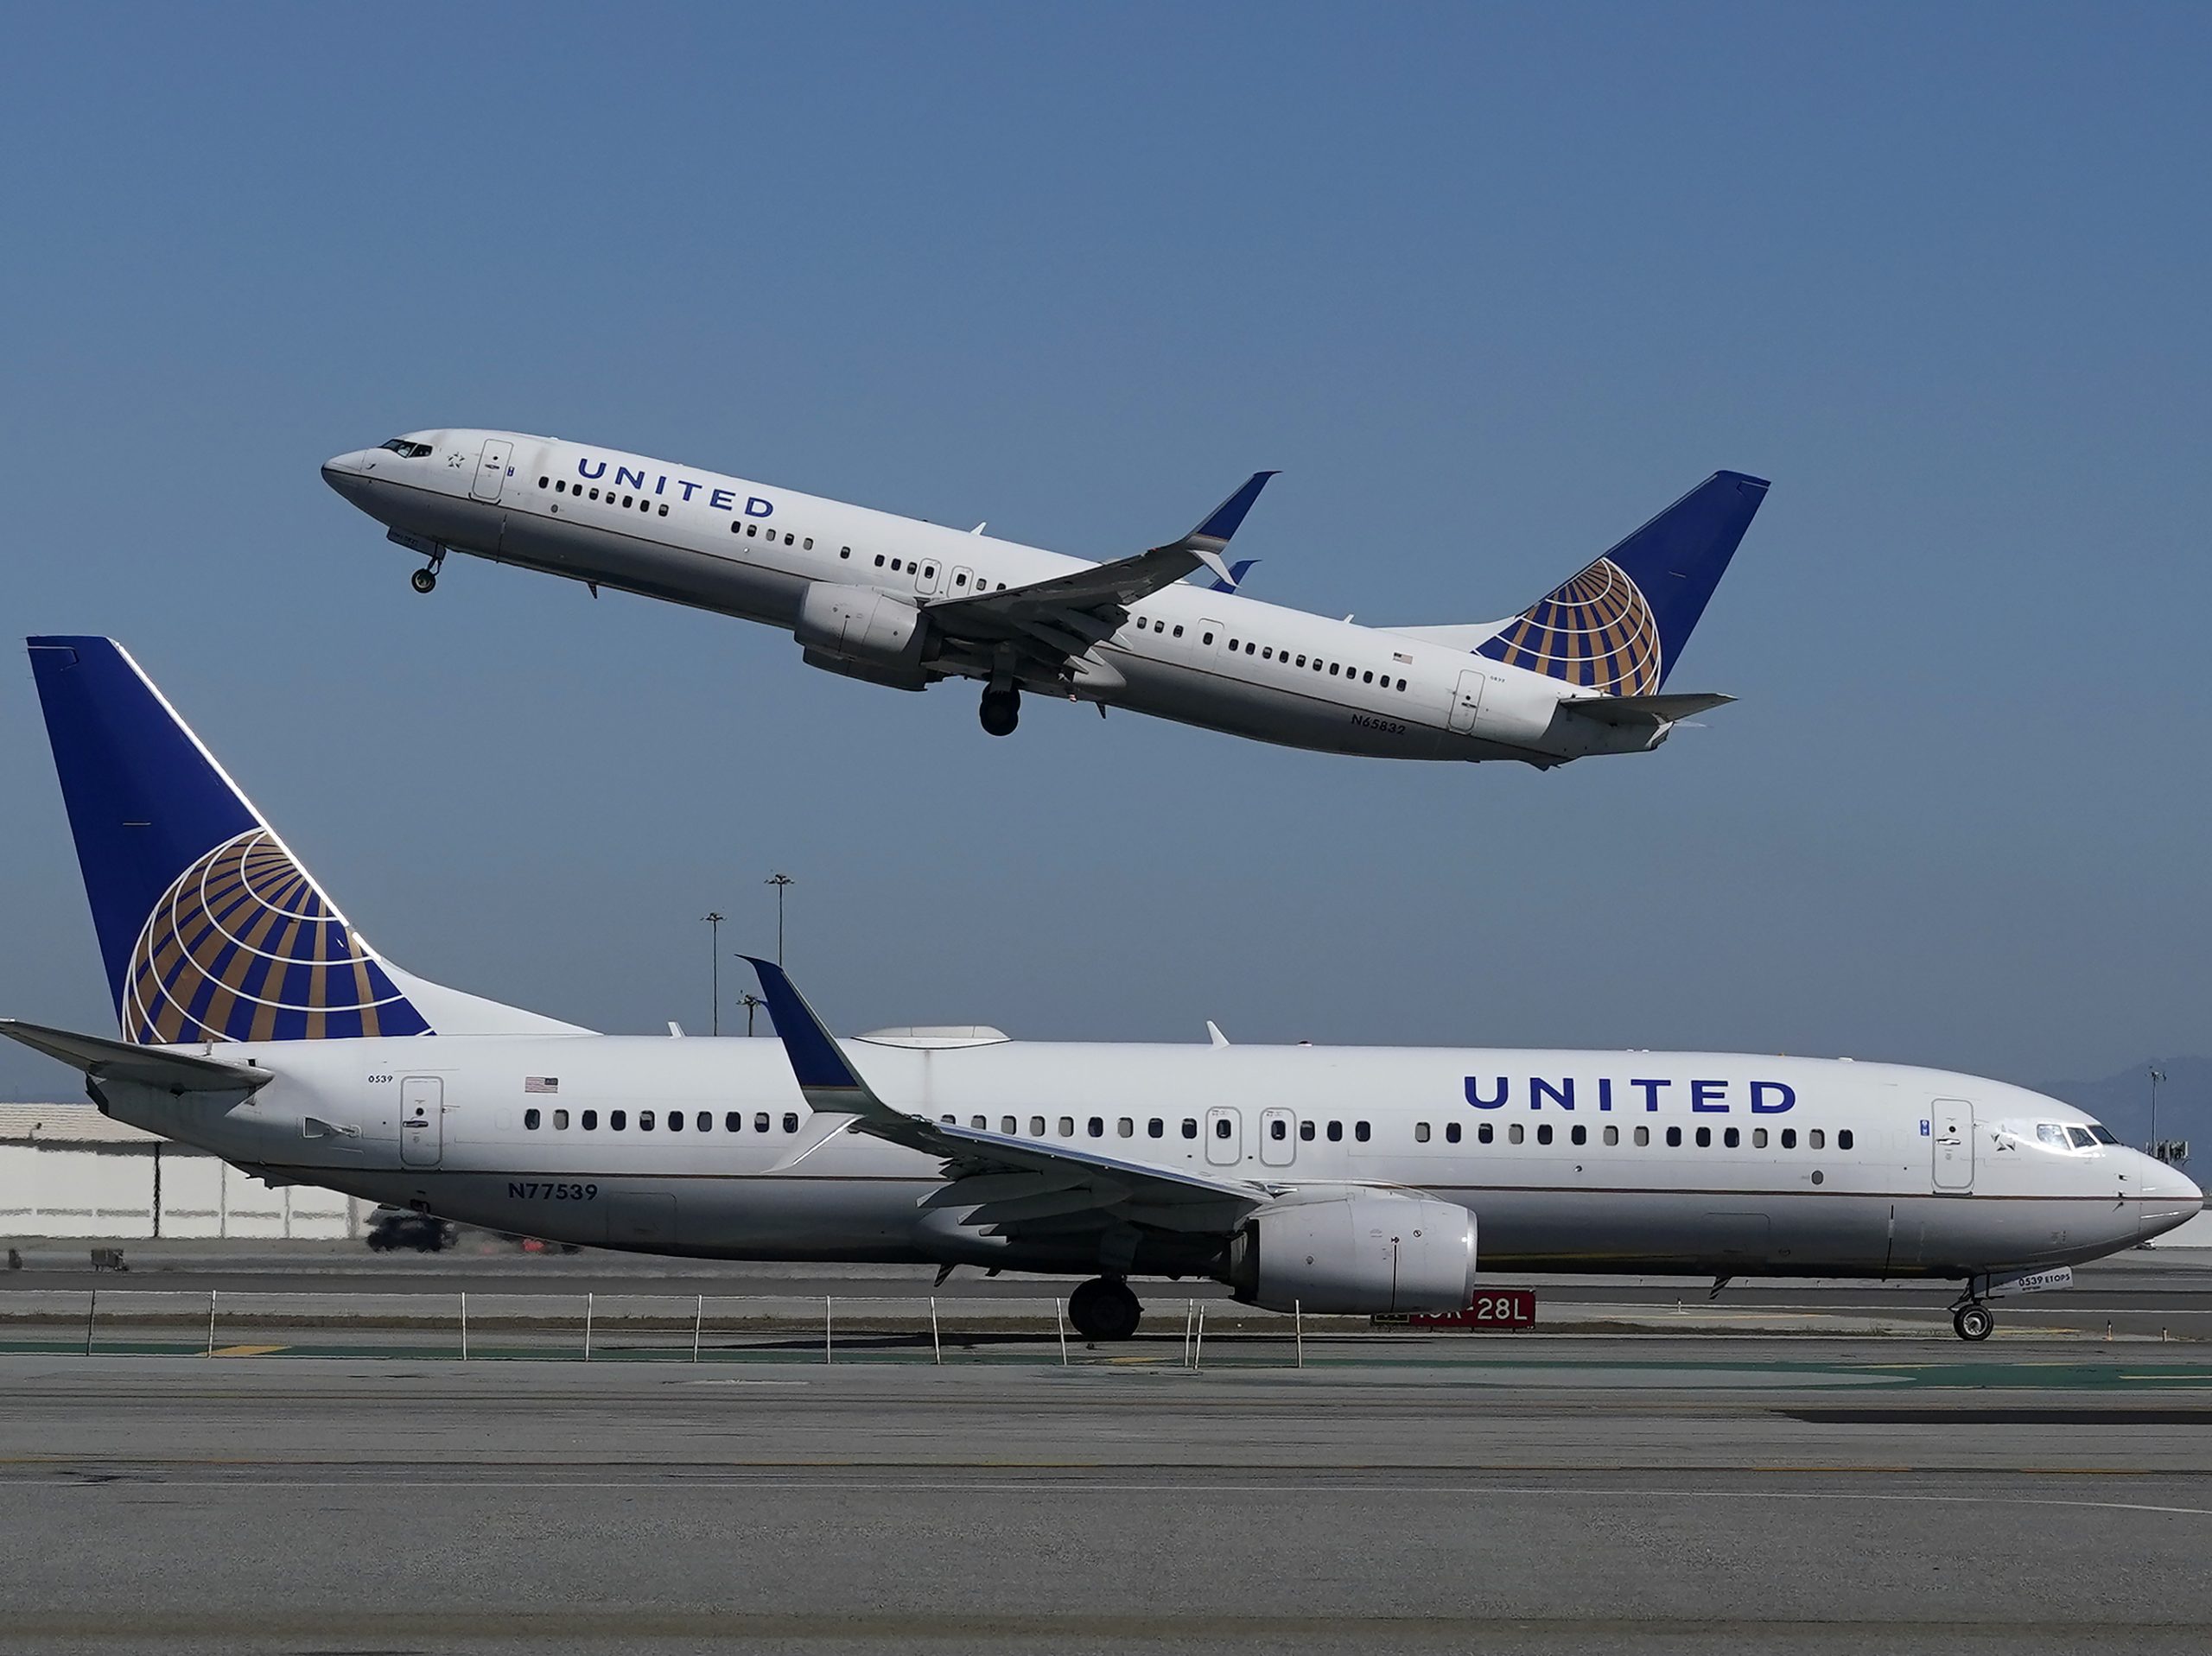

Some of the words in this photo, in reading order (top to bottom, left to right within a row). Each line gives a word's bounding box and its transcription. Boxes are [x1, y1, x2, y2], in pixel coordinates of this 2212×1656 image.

[578, 458, 774, 518] UNITED
[1351, 714, 1406, 735] N65832
[368, 1075, 393, 1083] 0539
[1464, 1075, 1796, 1114] UNITED
[508, 1183, 598, 1200] N77539
[2018, 1276, 2044, 1286] 0539
